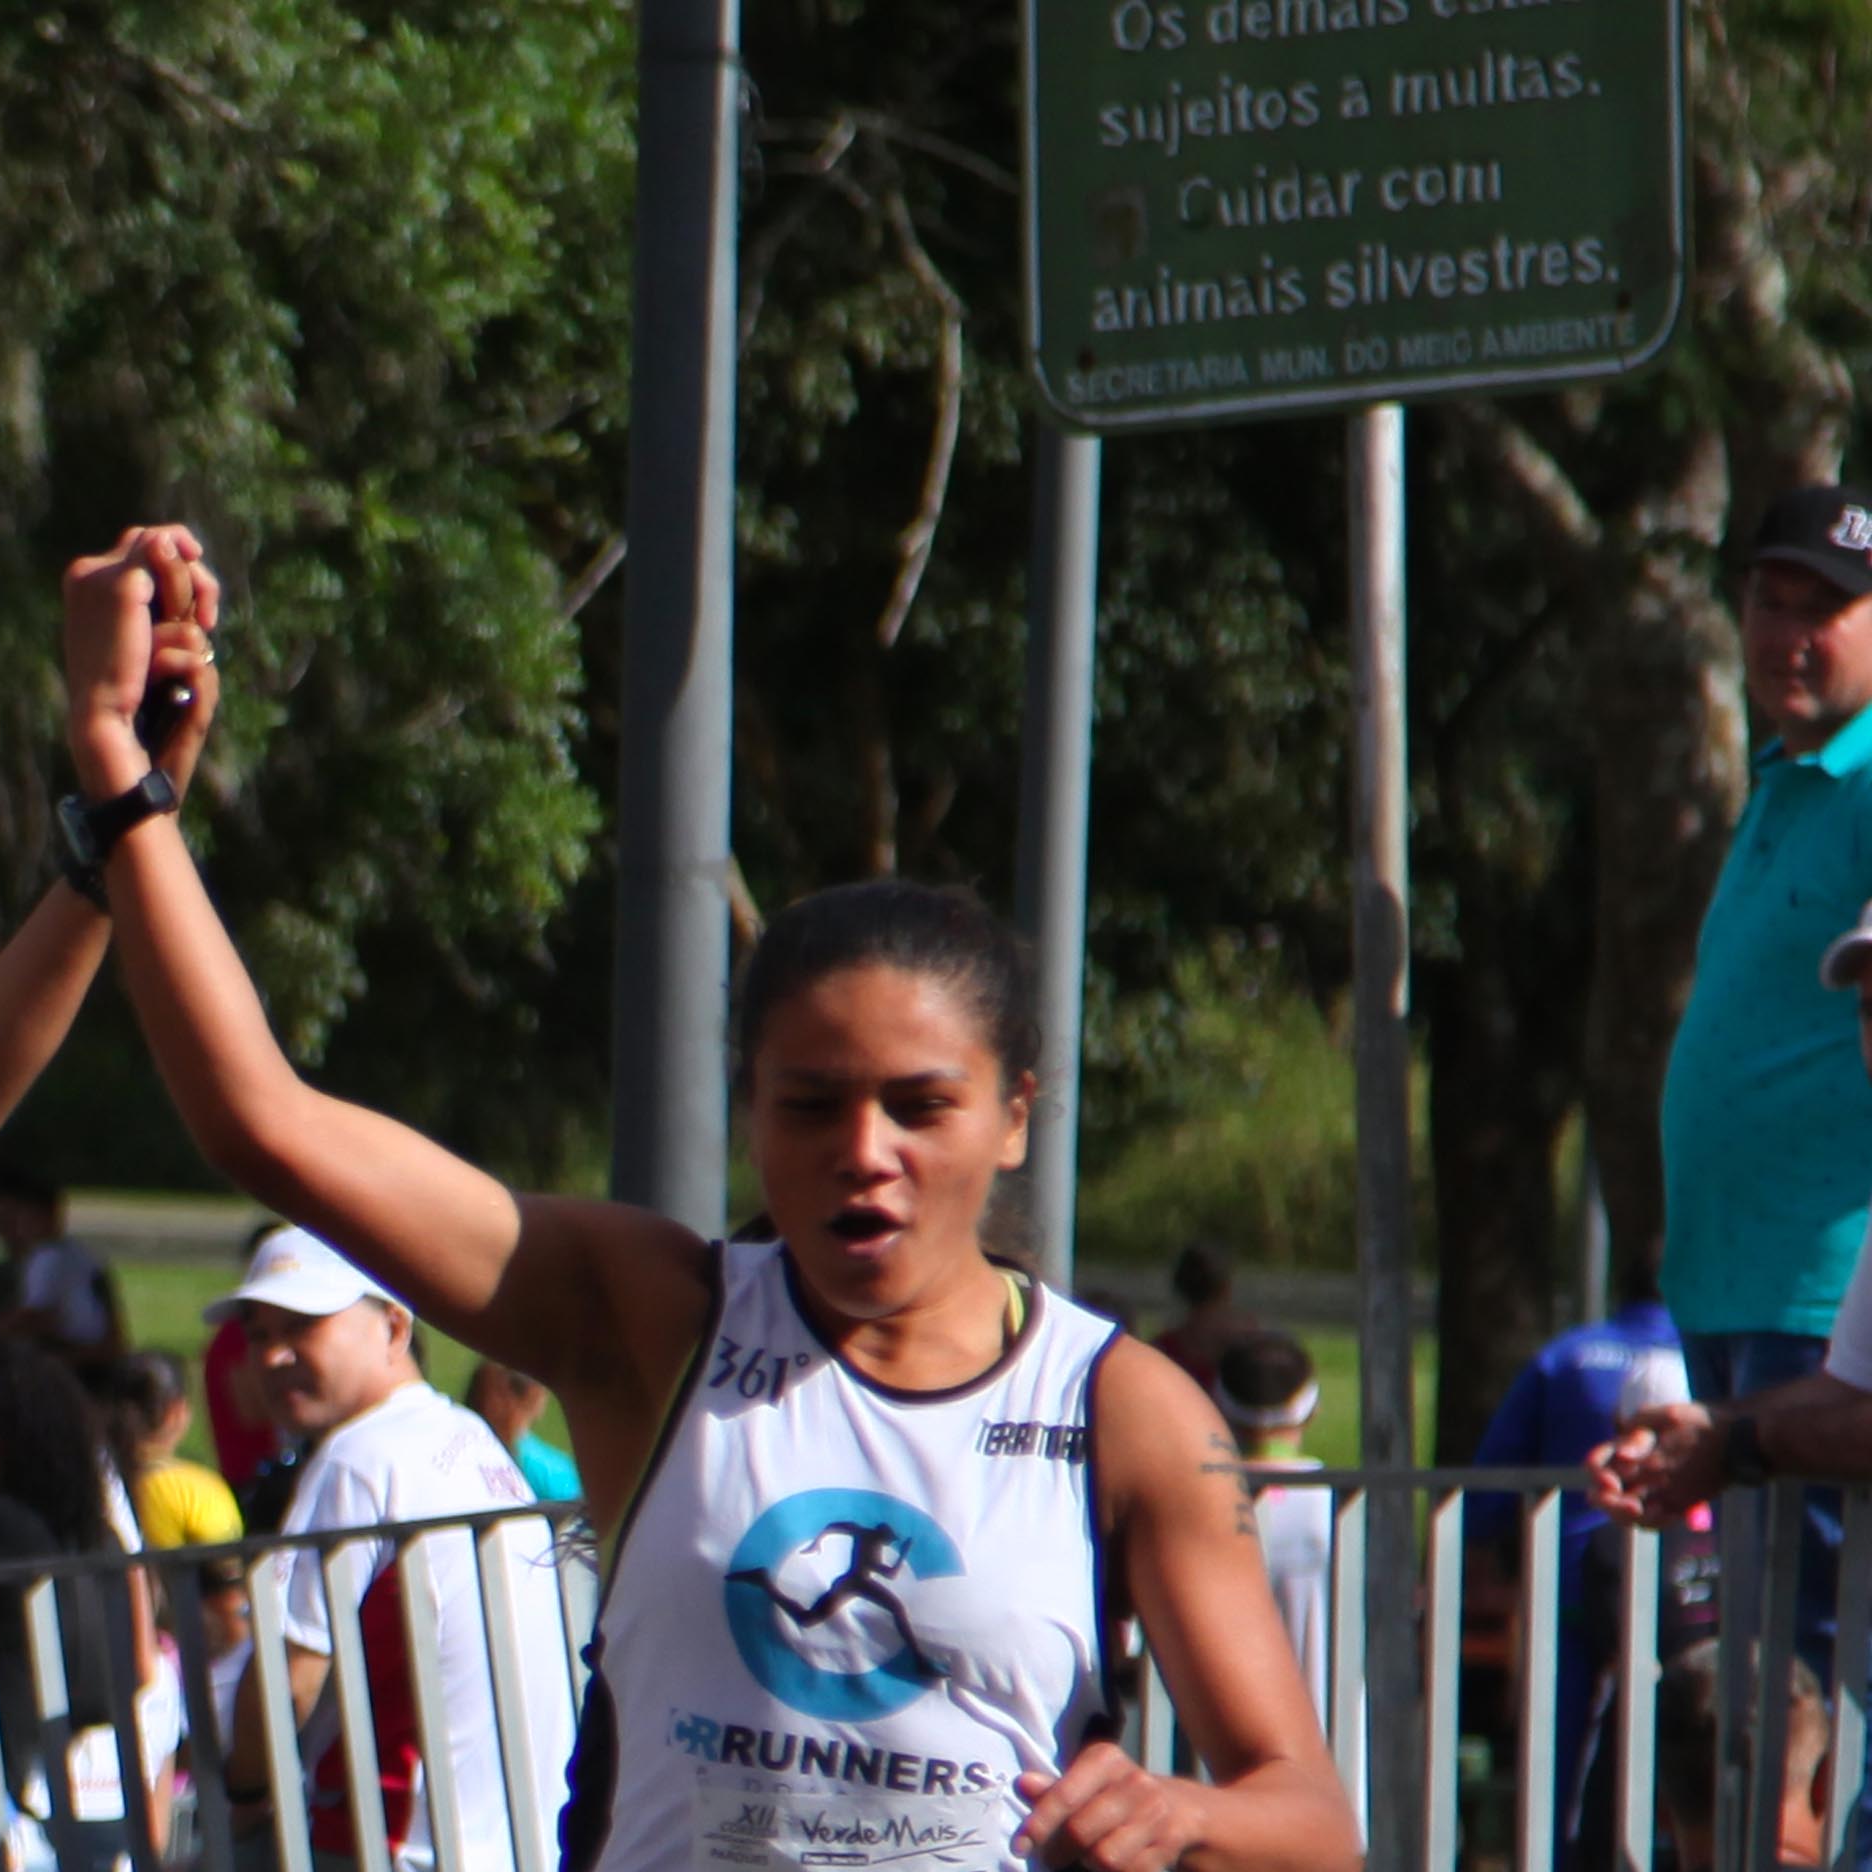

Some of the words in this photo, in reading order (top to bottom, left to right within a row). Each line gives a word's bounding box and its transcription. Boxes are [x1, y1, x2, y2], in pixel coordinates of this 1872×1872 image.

[1111, 0, 1188, 51] Os
[1098, 73, 1320, 156] sujeitos
[1339, 74, 1370, 120] a
[1391, 48, 1602, 116] multas.
[1177, 160, 1362, 229] Cuidar
[1380, 158, 1503, 212] com
[1090, 255, 1307, 333] animais
[1324, 233, 1620, 311] silvestres.
[1066, 346, 1249, 405] SECRETARIA
[1260, 345, 1335, 388] MUN.
[1344, 336, 1390, 375] DO
[1398, 331, 1473, 371] MEIO
[1479, 312, 1637, 361] AMBIENTE
